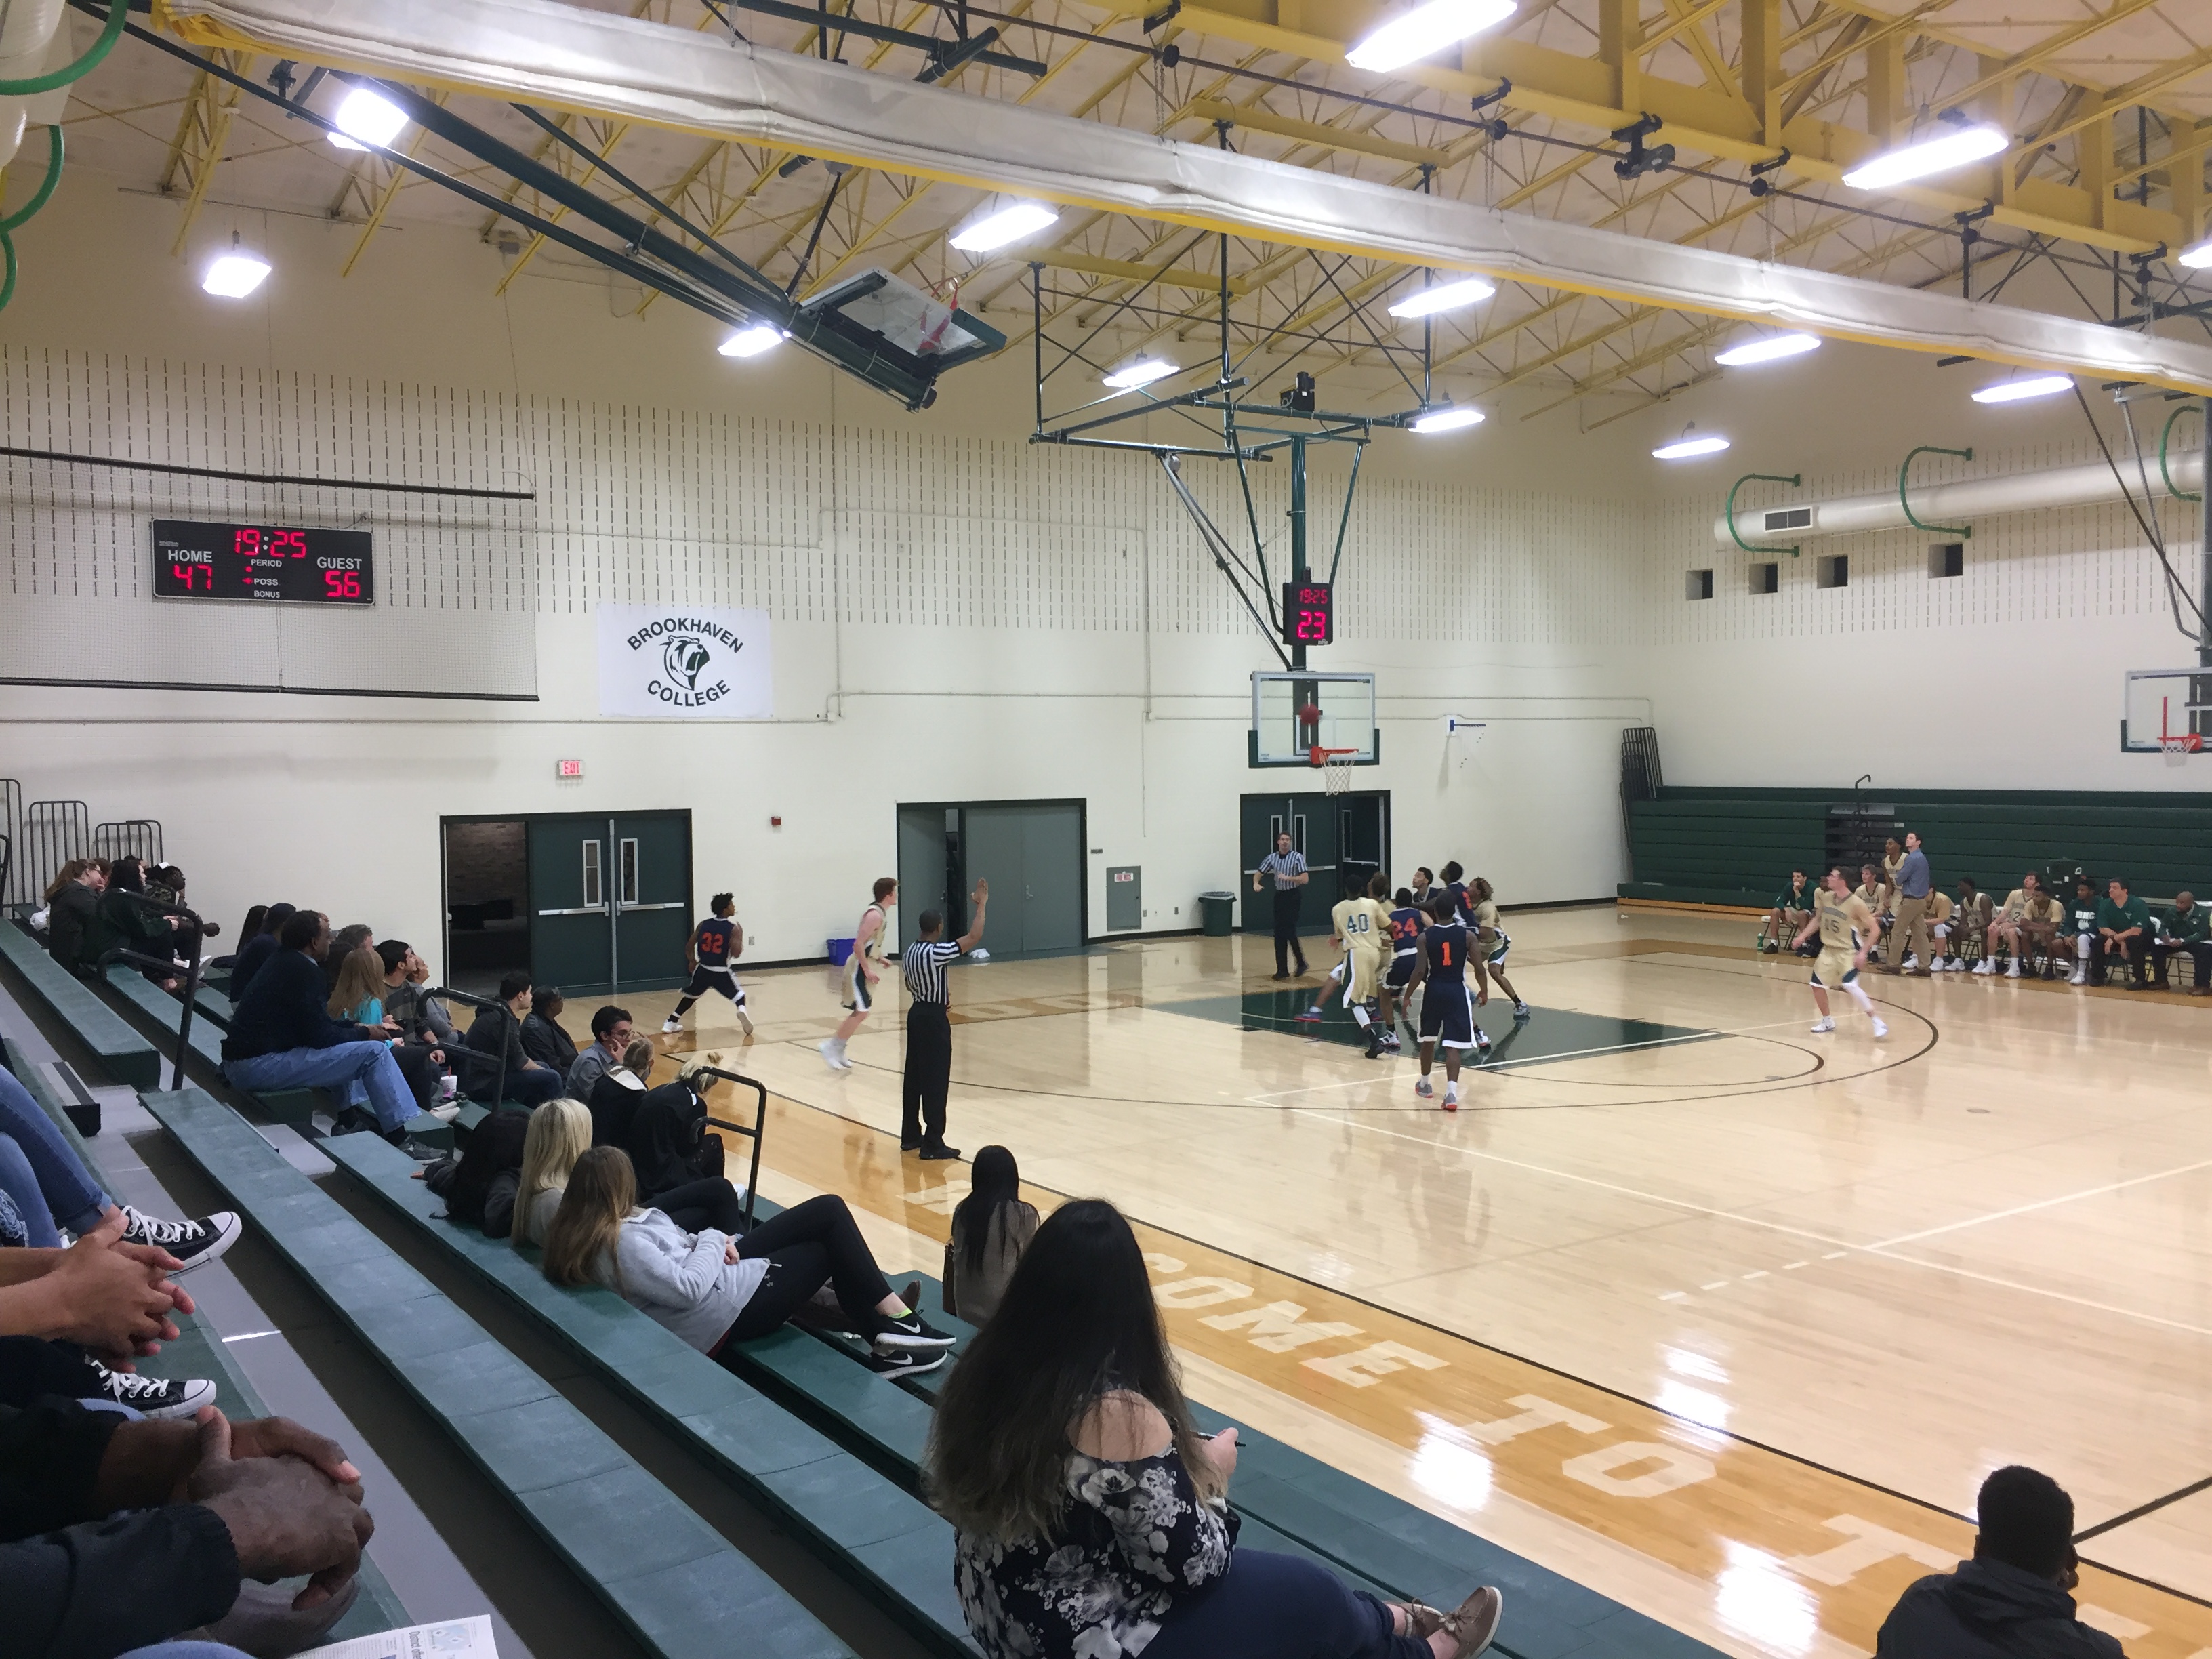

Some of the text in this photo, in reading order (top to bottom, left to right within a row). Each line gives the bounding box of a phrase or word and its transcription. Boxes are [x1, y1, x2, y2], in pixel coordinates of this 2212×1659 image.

[234, 529, 307, 558] 19:25
[167, 550, 213, 563] HOME
[251, 559, 282, 567] PERIOD
[316, 556, 363, 570] GUEST
[173, 565, 213, 590] 47
[325, 571, 361, 598] 56
[253, 590, 280, 598] BONUS
[627, 618, 743, 653] BROOKHAVEN
[1297, 611, 1326, 638] 23
[647, 680, 731, 707] COLLEGE
[564, 762, 580, 775] EXIT
[1347, 913, 1370, 933] 40
[1392, 917, 1418, 940] 24
[701, 932, 724, 954] 32
[1441, 941, 1452, 966] 1
